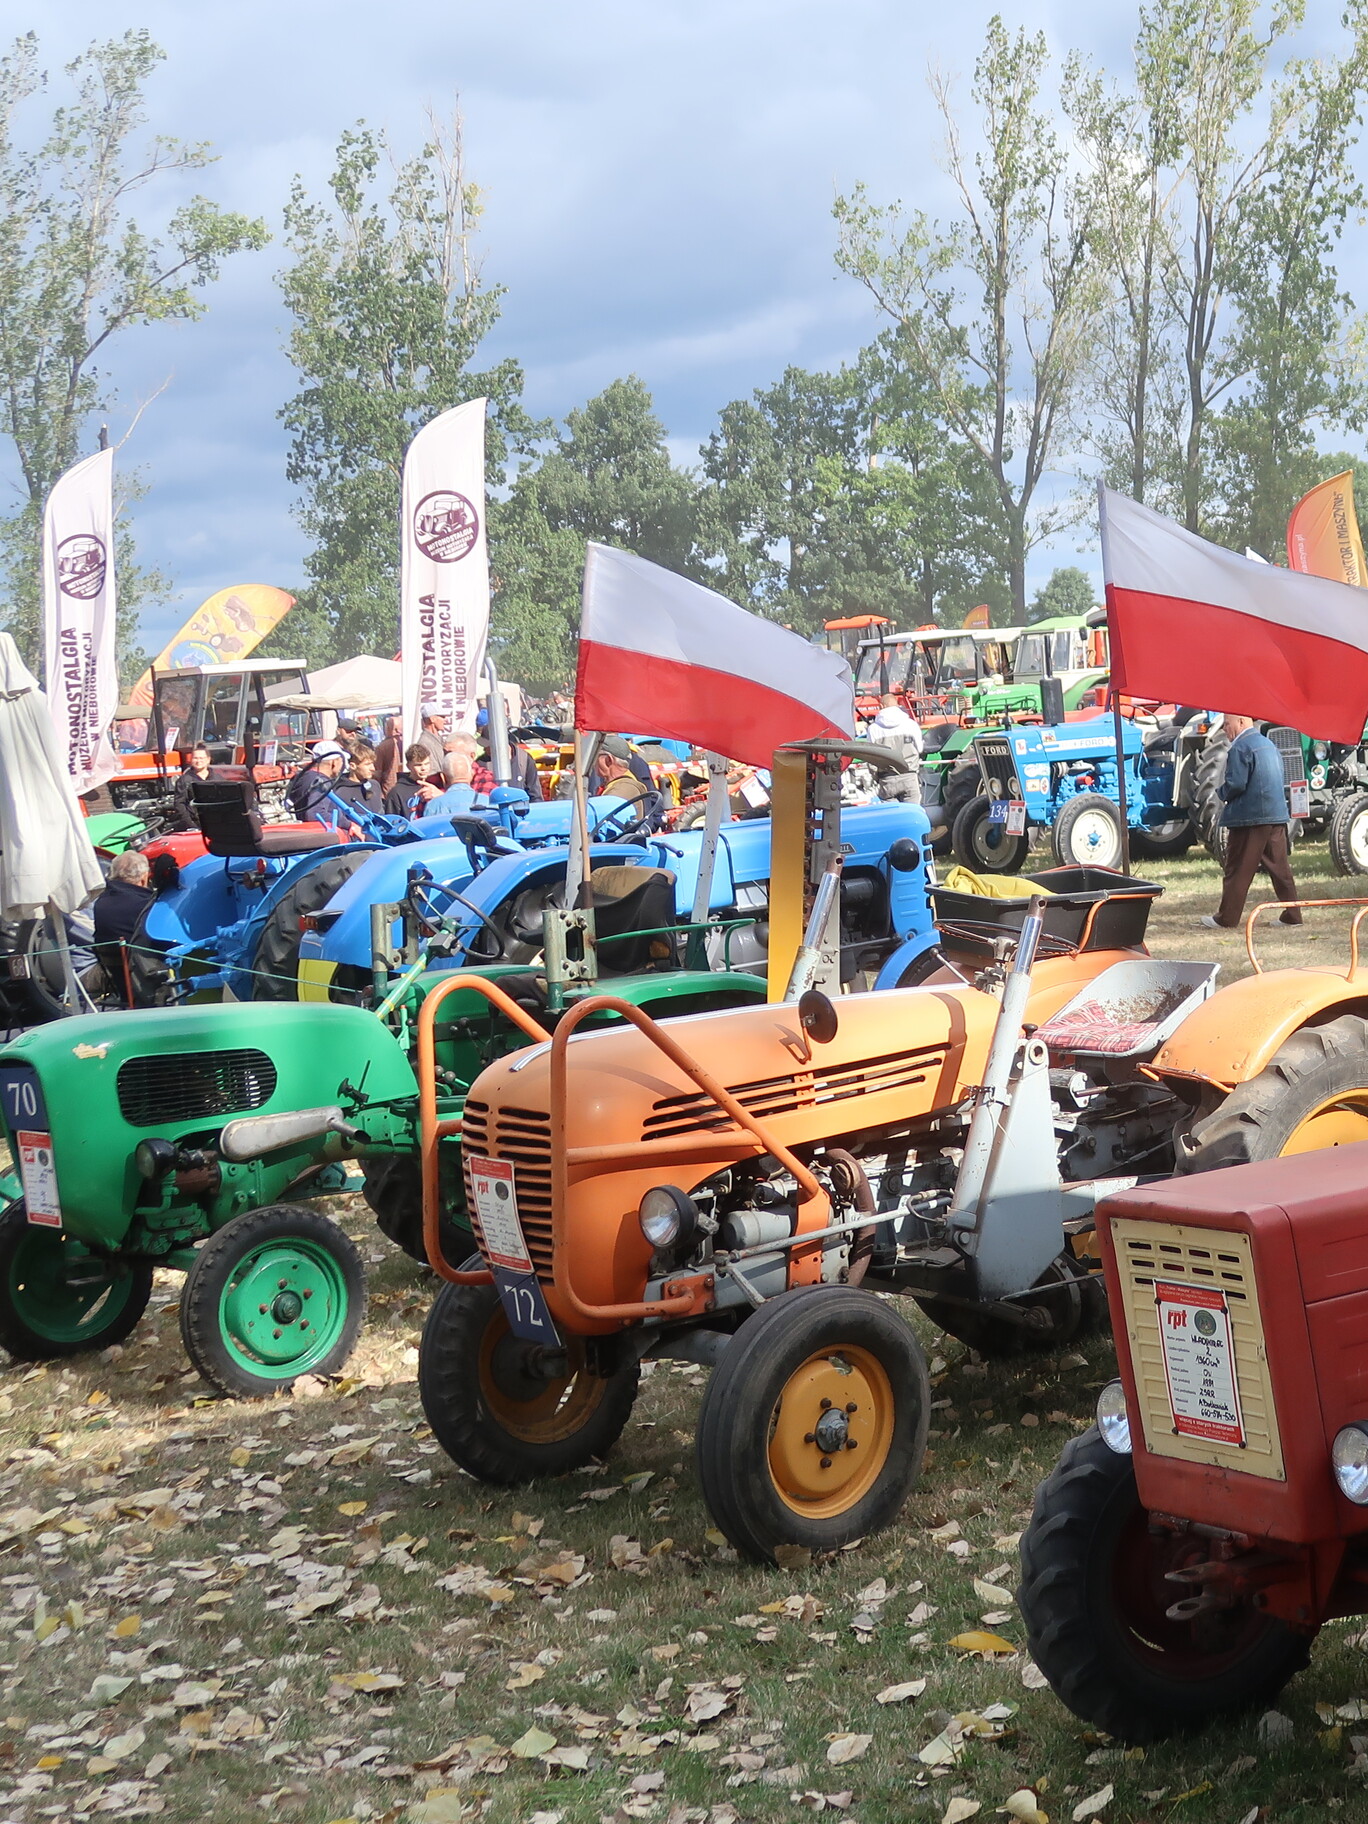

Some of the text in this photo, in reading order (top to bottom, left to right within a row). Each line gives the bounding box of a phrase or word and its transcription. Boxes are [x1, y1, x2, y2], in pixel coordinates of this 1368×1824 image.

[438, 600, 453, 693] MOTORYZACJI
[454, 626, 467, 720] W NIEBOROWIE
[61, 627, 82, 775] MOTONOSTALGIA
[79, 722, 92, 770] MUZEUM
[90, 733, 100, 742] W
[984, 746, 1008, 755] FORD
[1079, 738, 1105, 747] FORD
[989, 804, 1007, 819] 134
[7, 1082, 37, 1116] 70
[504, 1284, 544, 1327] 72
[1167, 1310, 1187, 1330] rpt
[1206, 1346, 1212, 1356] 2
